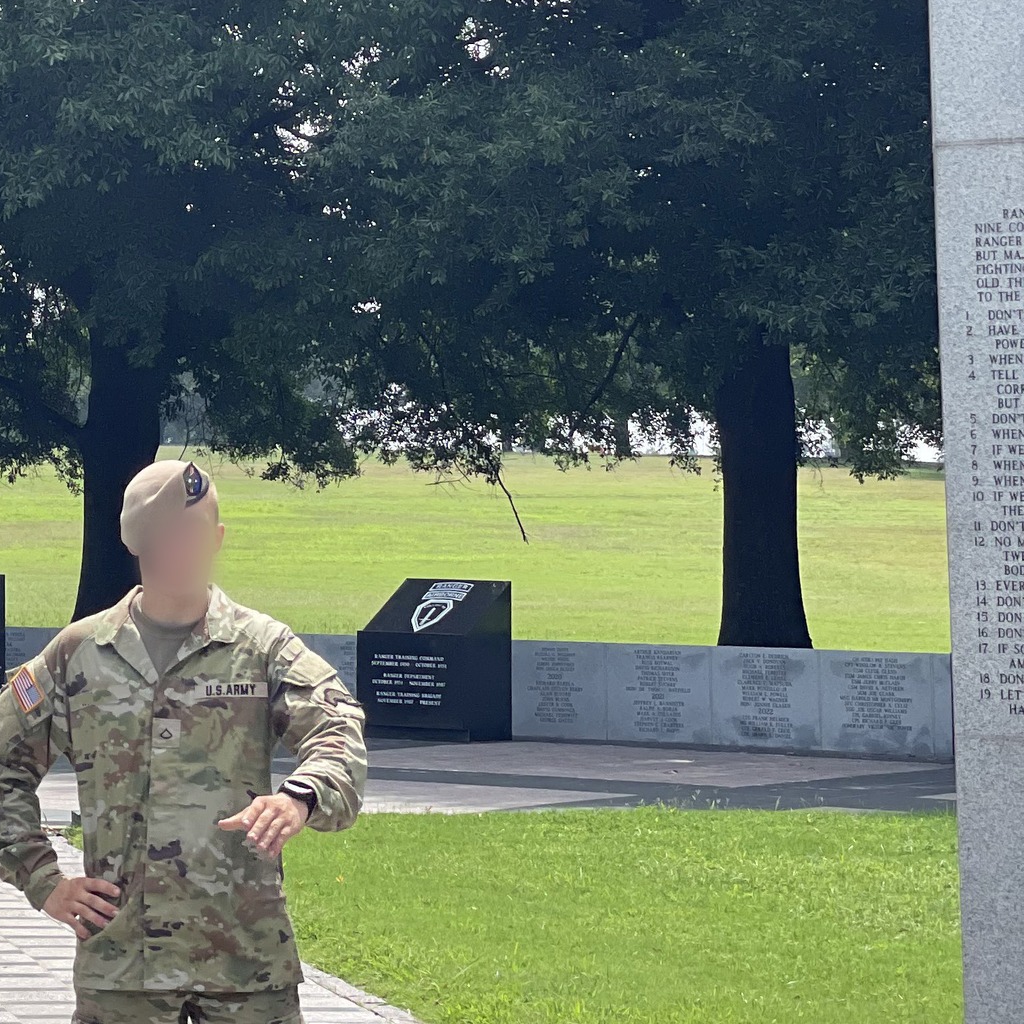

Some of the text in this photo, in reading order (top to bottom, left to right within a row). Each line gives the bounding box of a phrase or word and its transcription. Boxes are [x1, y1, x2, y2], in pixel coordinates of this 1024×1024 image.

[975, 222, 1024, 233] NINE CO
[976, 236, 1022, 247] RANGER
[976, 251, 1024, 260] BUT MA
[977, 291, 1020, 302] TO THE
[988, 310, 1023, 320] DON'T
[989, 325, 1018, 336] HAVE
[989, 355, 1023, 365] WHEN
[991, 370, 1018, 380] TELL
[998, 398, 1020, 408] BUT
[992, 429, 1024, 439] WHEN
[992, 445, 1002, 455] IF
[973, 491, 984, 501] 10
[993, 491, 1003, 501] IF
[975, 537, 985, 546] 12
[995, 537, 1011, 547] NO
[977, 580, 986, 590] 13
[977, 596, 987, 606] 14
[977, 612, 988, 622] 15
[978, 627, 987, 637] 16
[979, 643, 988, 653] 17
[998, 644, 1008, 653] IF
[980, 673, 990, 683] 18
[981, 689, 1022, 700] 19 LET
